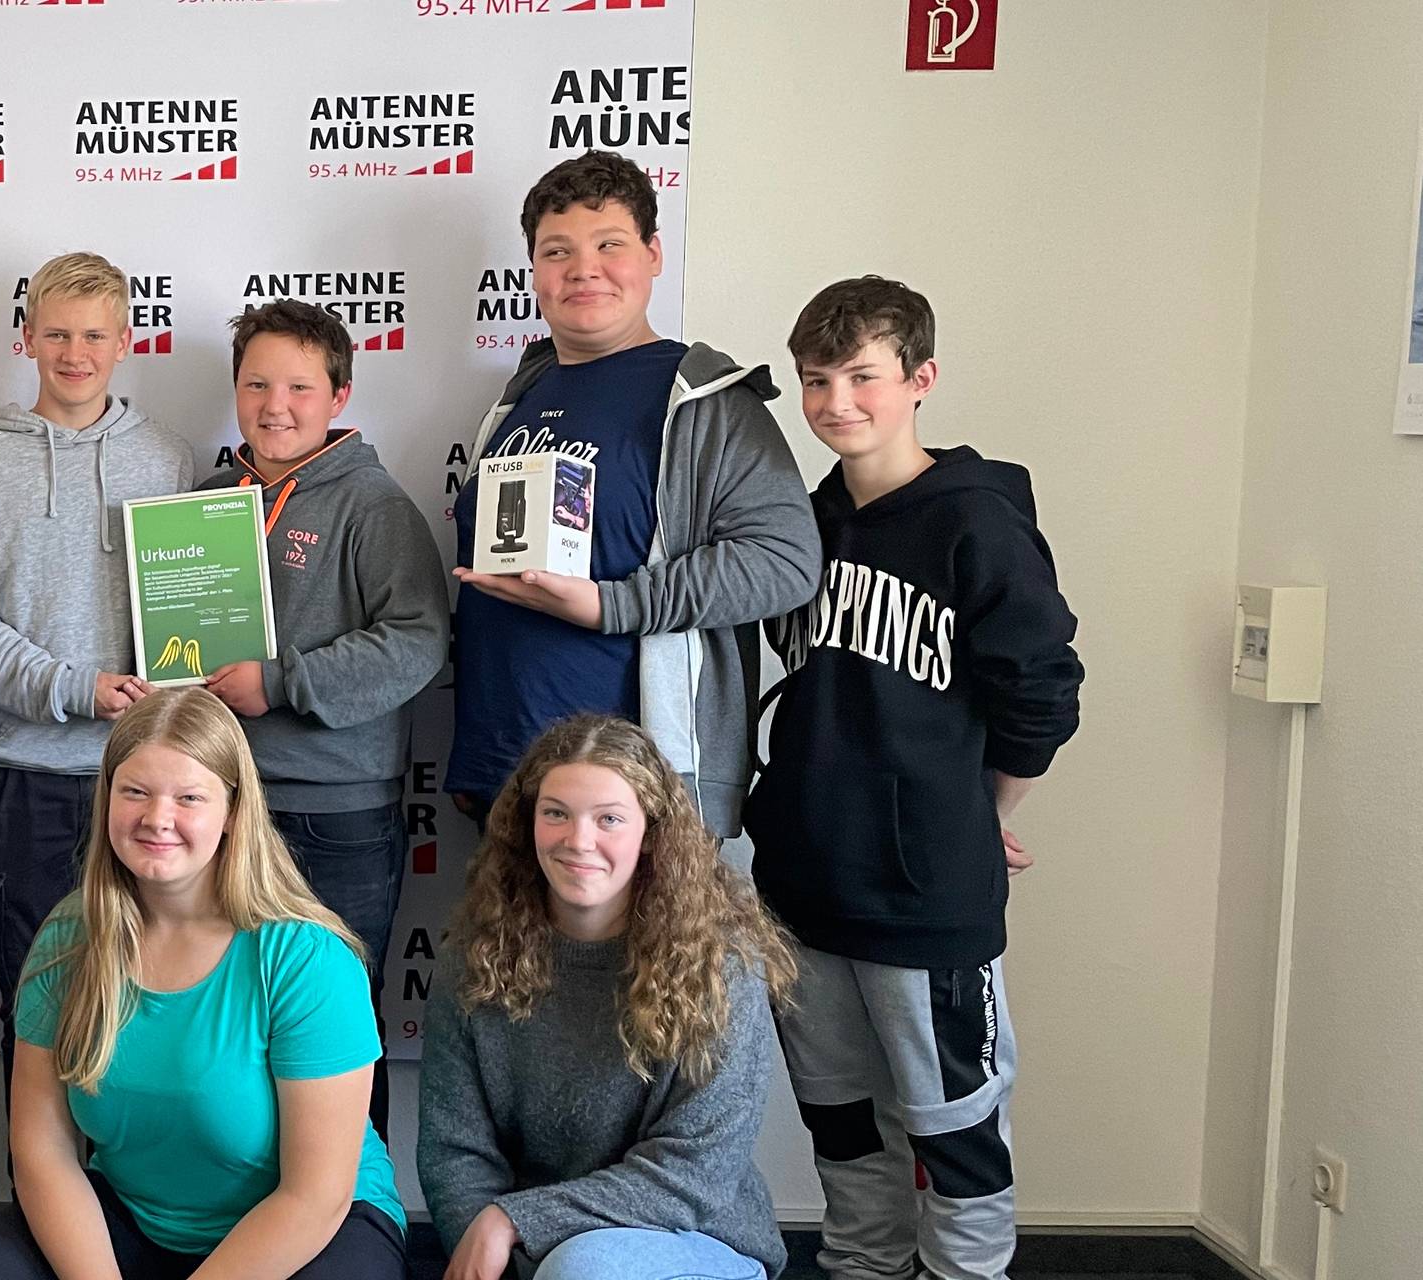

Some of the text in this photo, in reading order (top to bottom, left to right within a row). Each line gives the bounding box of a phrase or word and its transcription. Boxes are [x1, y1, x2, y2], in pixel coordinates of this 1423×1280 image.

[417, 0, 550, 16] 95.4 MHz
[551, 66, 688, 104] ANTE
[76, 101, 238, 125] ANTENNE
[310, 94, 475, 121] ANTENNE
[75, 126, 238, 154] MÜNSTER
[309, 122, 474, 150] MÜNSTER
[75, 167, 163, 183] 95.4 MHz
[309, 163, 397, 178] 95.4 MHz
[646, 166, 680, 187] Hz
[243, 272, 405, 297] ANTENNE
[476, 335, 515, 349] 95.4
[540, 410, 564, 418] SINCE
[287, 529, 319, 545] CORE
[141, 543, 206, 564] Urkunde
[286, 550, 307, 563] 1975
